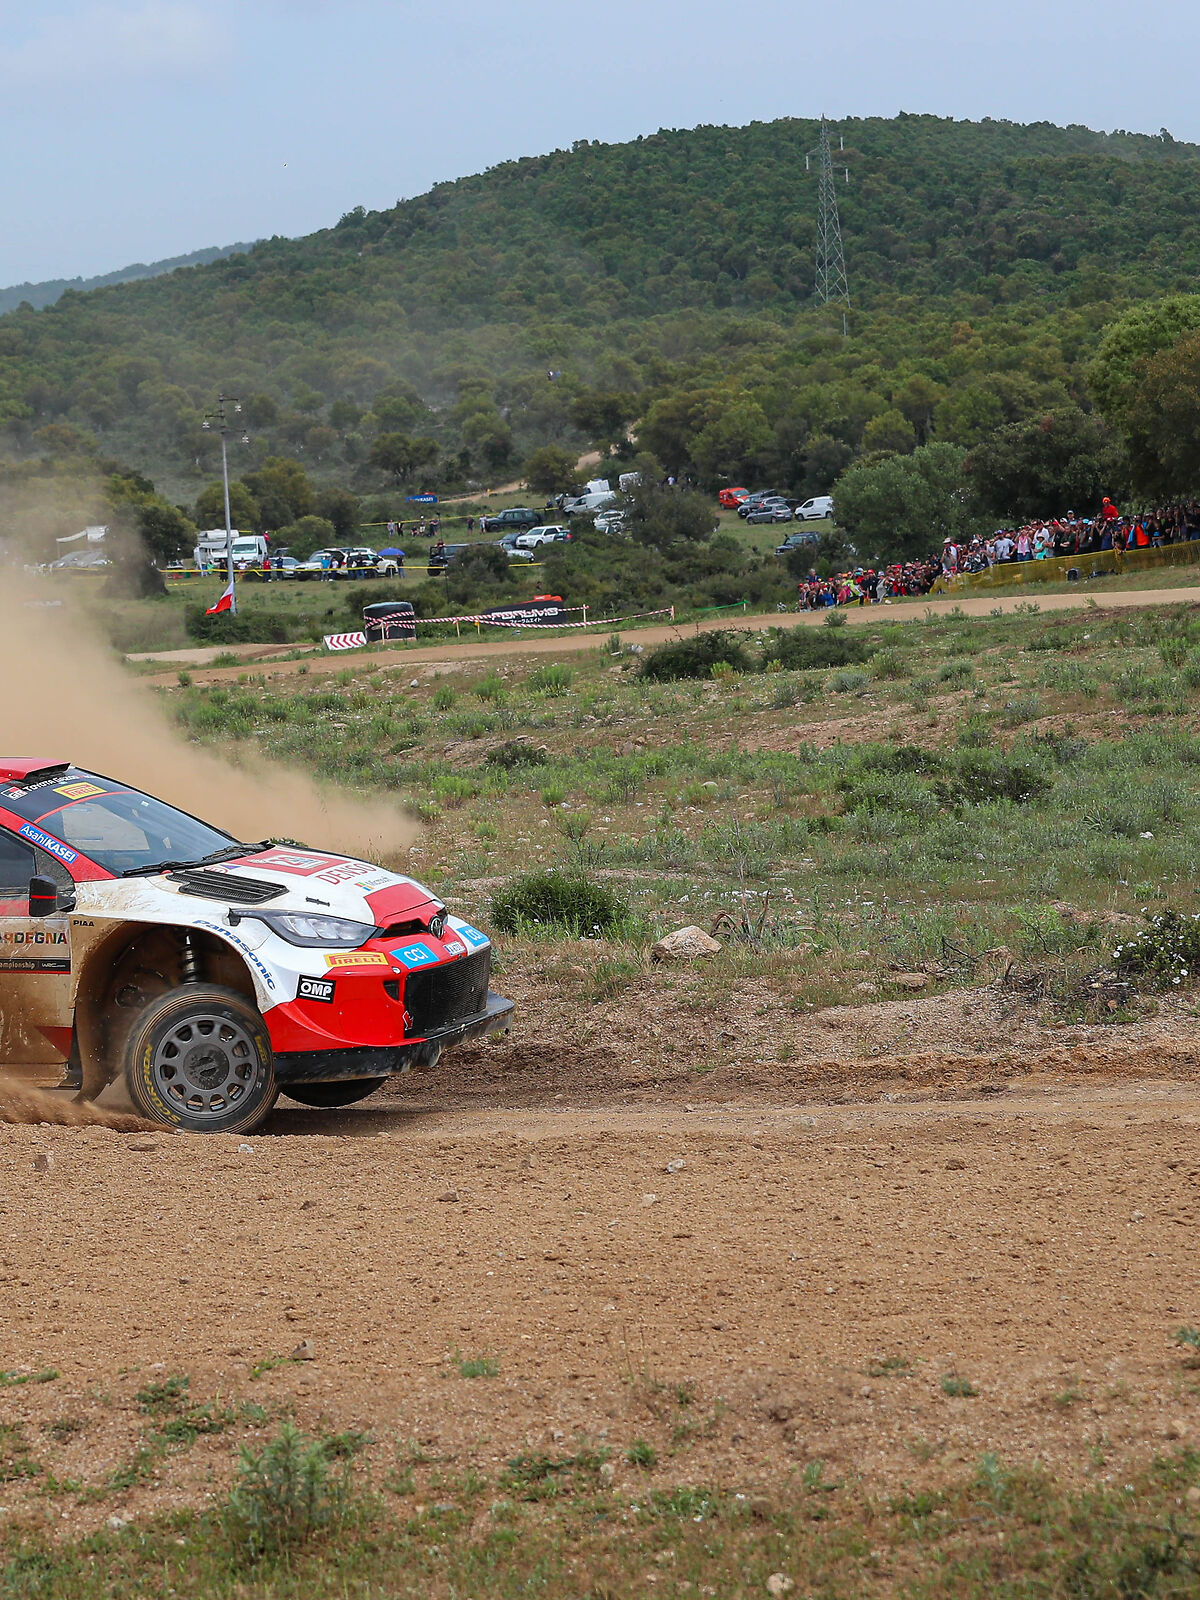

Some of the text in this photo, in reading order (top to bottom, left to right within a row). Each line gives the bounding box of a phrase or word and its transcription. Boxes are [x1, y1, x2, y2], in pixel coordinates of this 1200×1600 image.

[316, 863, 377, 885] DENSO
[73, 919, 95, 927] PIAA
[192, 919, 276, 991] Panasonic
[331, 953, 383, 965] PIRELLI
[300, 982, 332, 998] OMP
